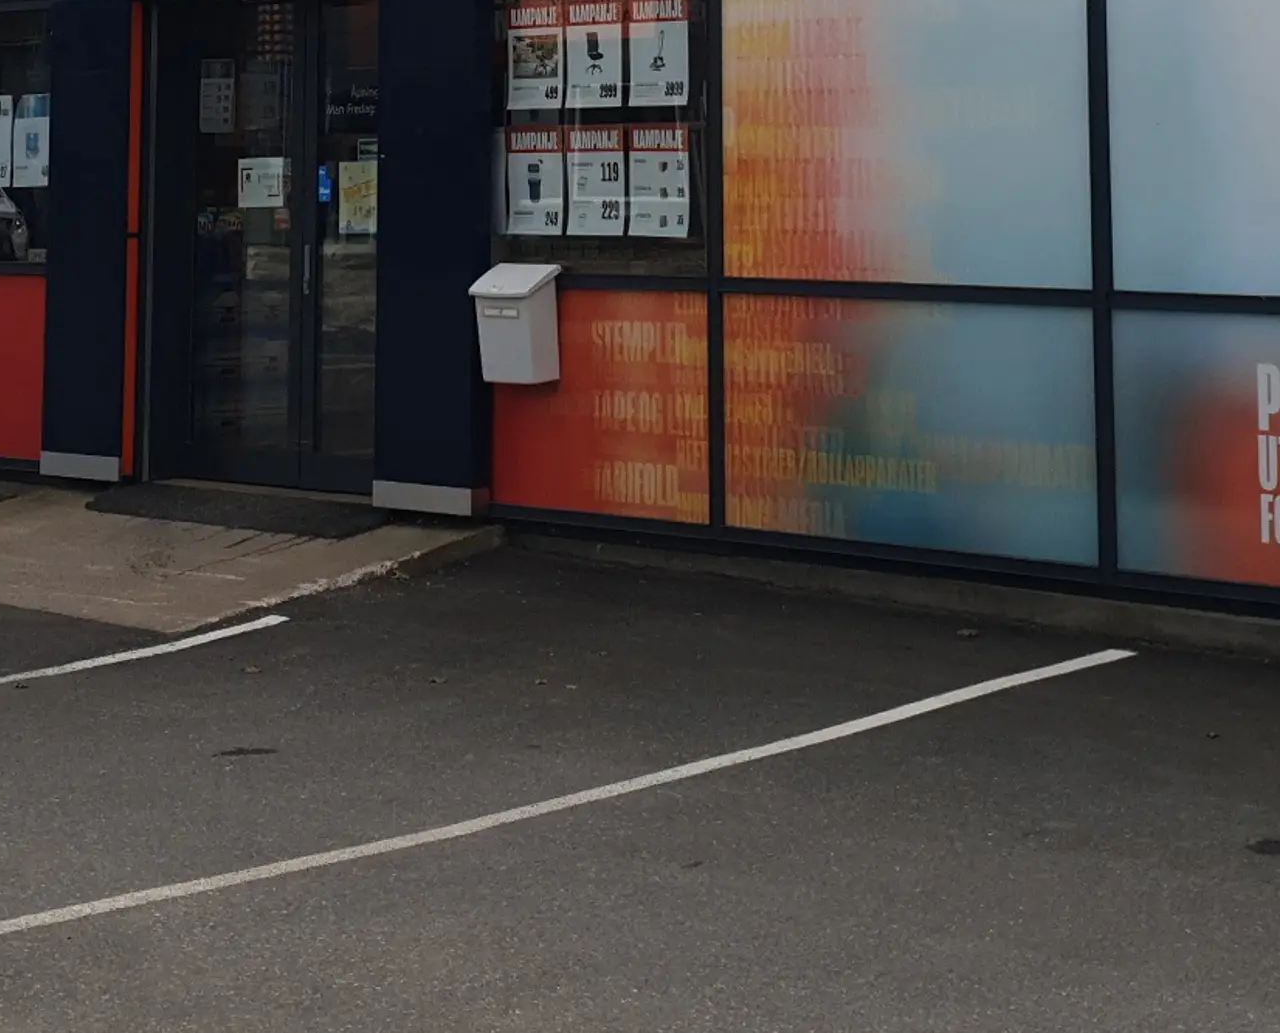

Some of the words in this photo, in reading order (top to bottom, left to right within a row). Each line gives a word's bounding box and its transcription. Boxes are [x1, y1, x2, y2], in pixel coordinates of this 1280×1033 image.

[511, 6, 557, 26] KAMPANJE
[570, 2, 617, 23] KAMPANJE
[633, 0, 683, 19] KAMPANJE
[511, 131, 558, 150] KAMPANJE
[570, 130, 619, 149] KAMPANJE
[633, 129, 683, 149] KAMPANJE
[600, 161, 619, 182] 119
